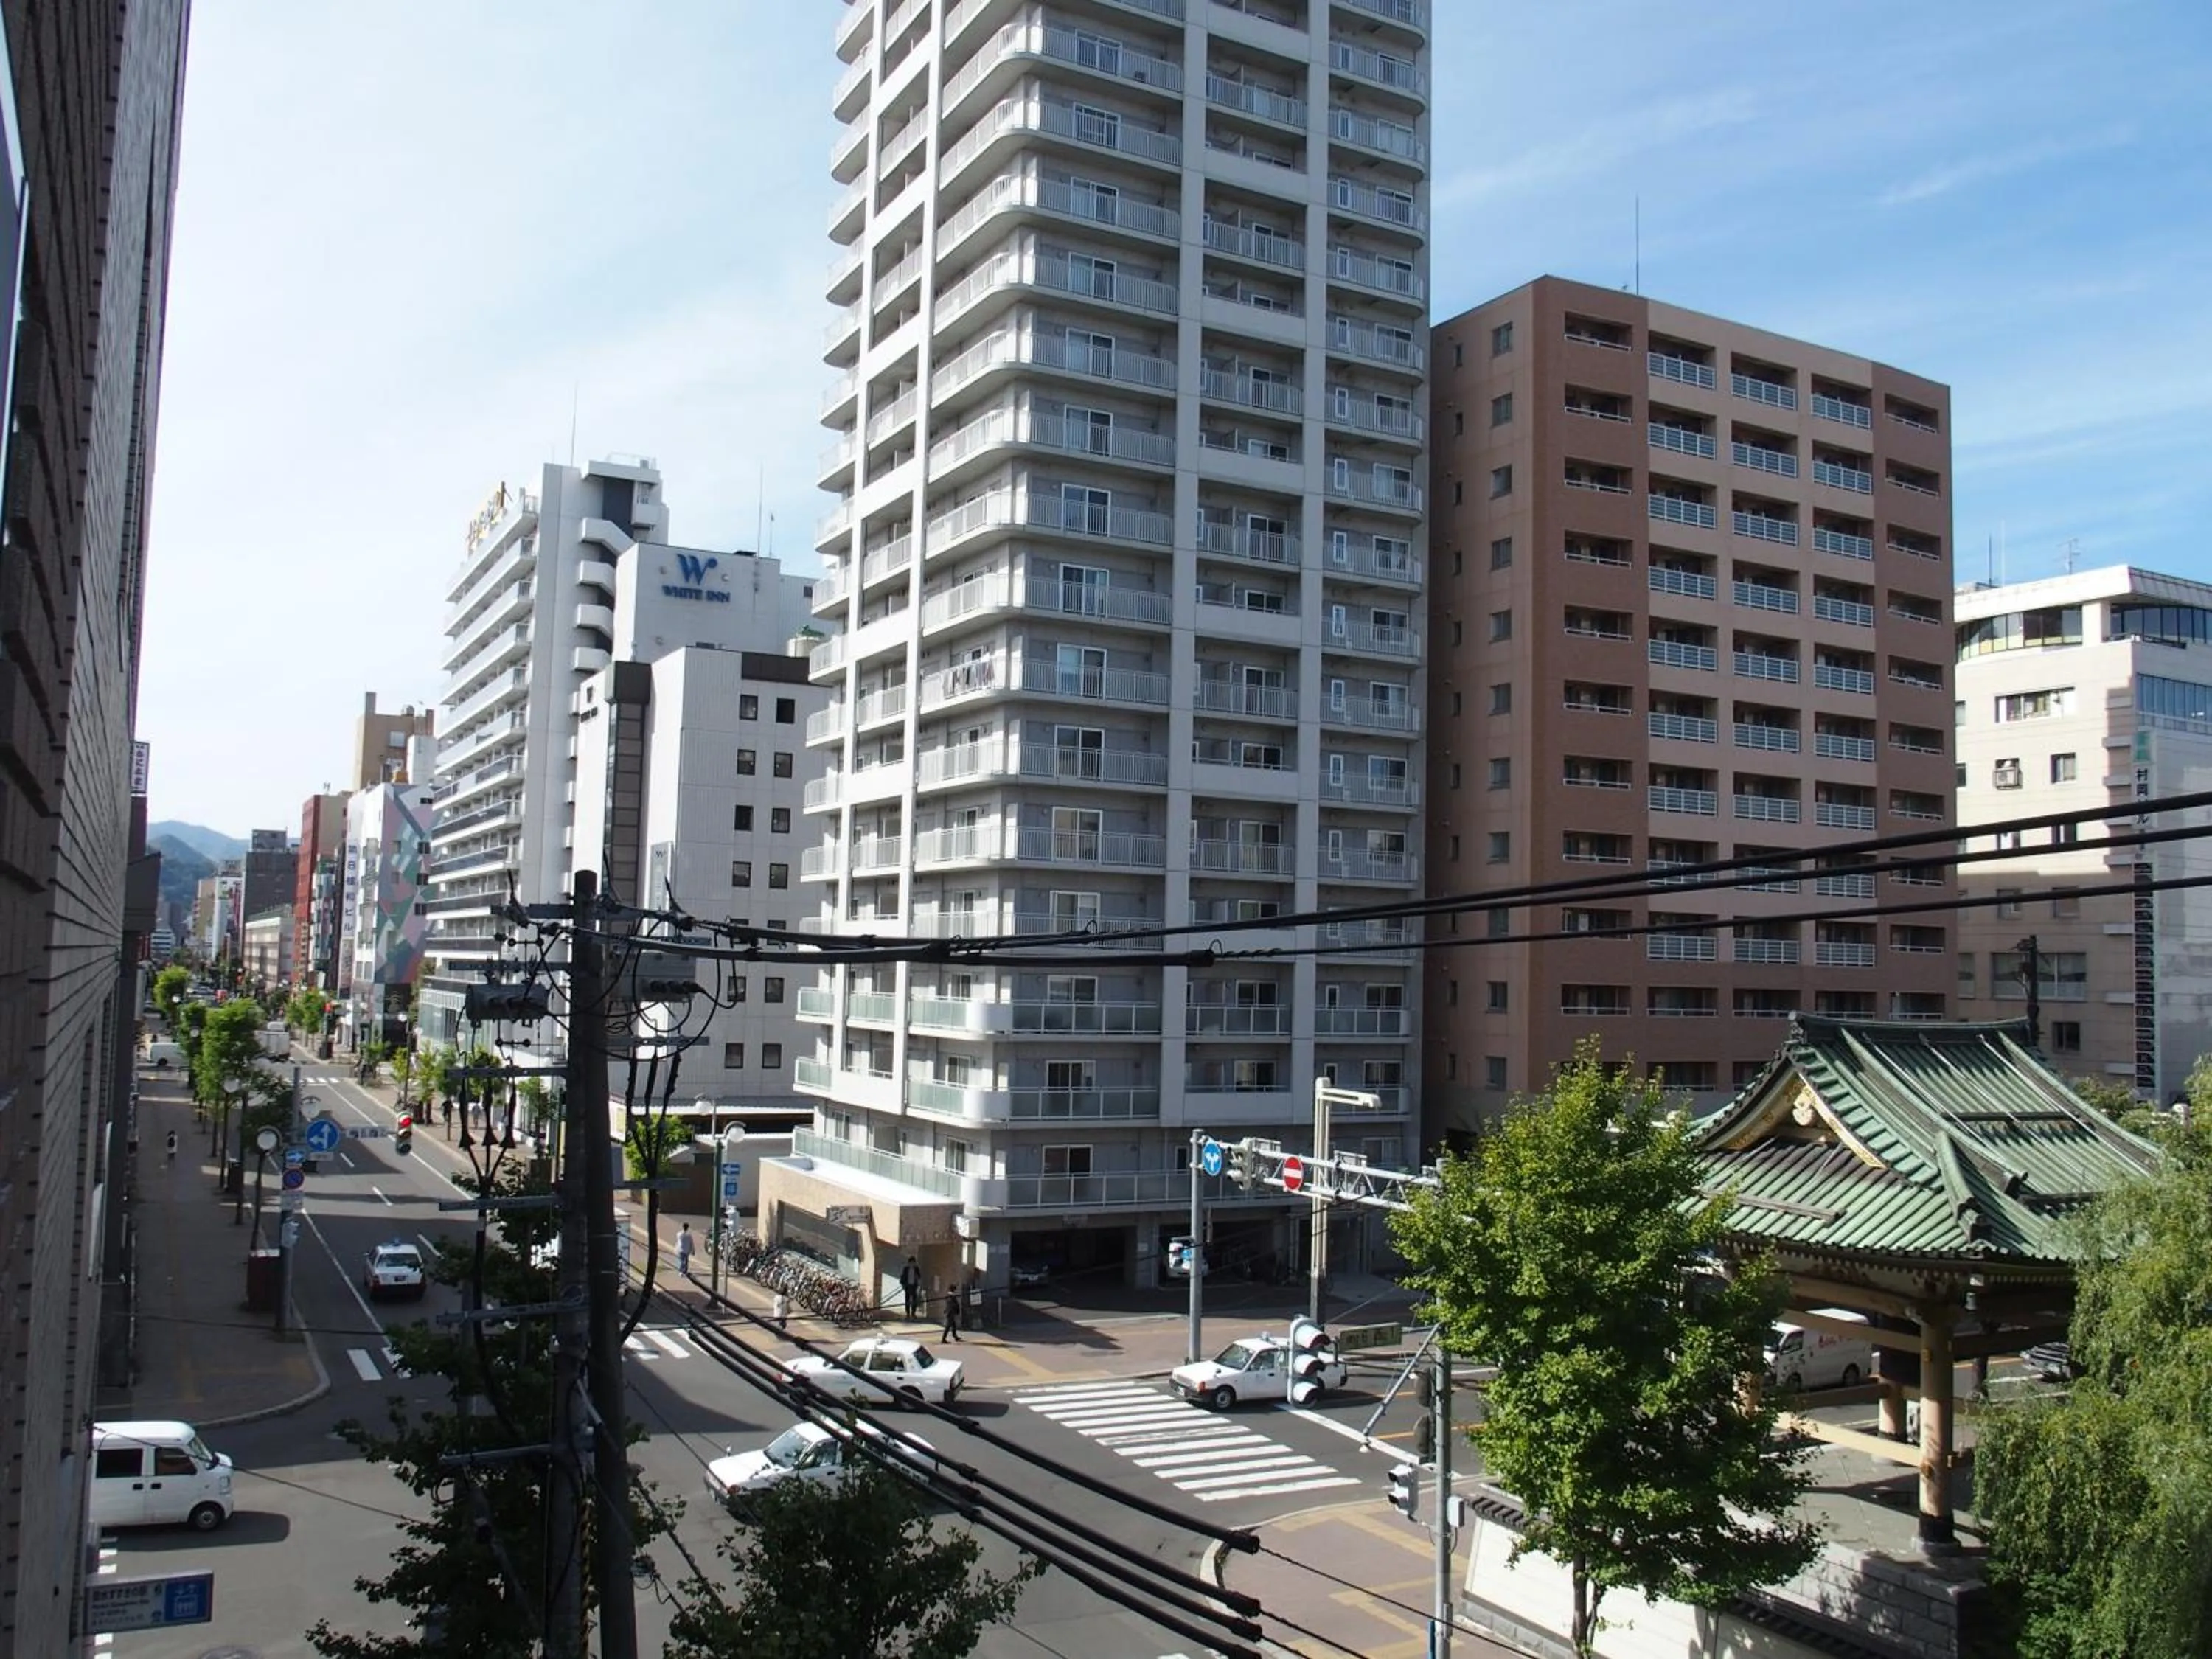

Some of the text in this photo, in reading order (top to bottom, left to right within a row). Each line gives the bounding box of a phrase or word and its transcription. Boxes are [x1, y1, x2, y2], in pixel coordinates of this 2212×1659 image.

[676, 554, 718, 586] W
[661, 585, 731, 603] WHITE INN
[2136, 768, 2149, 824] 村岡ル
